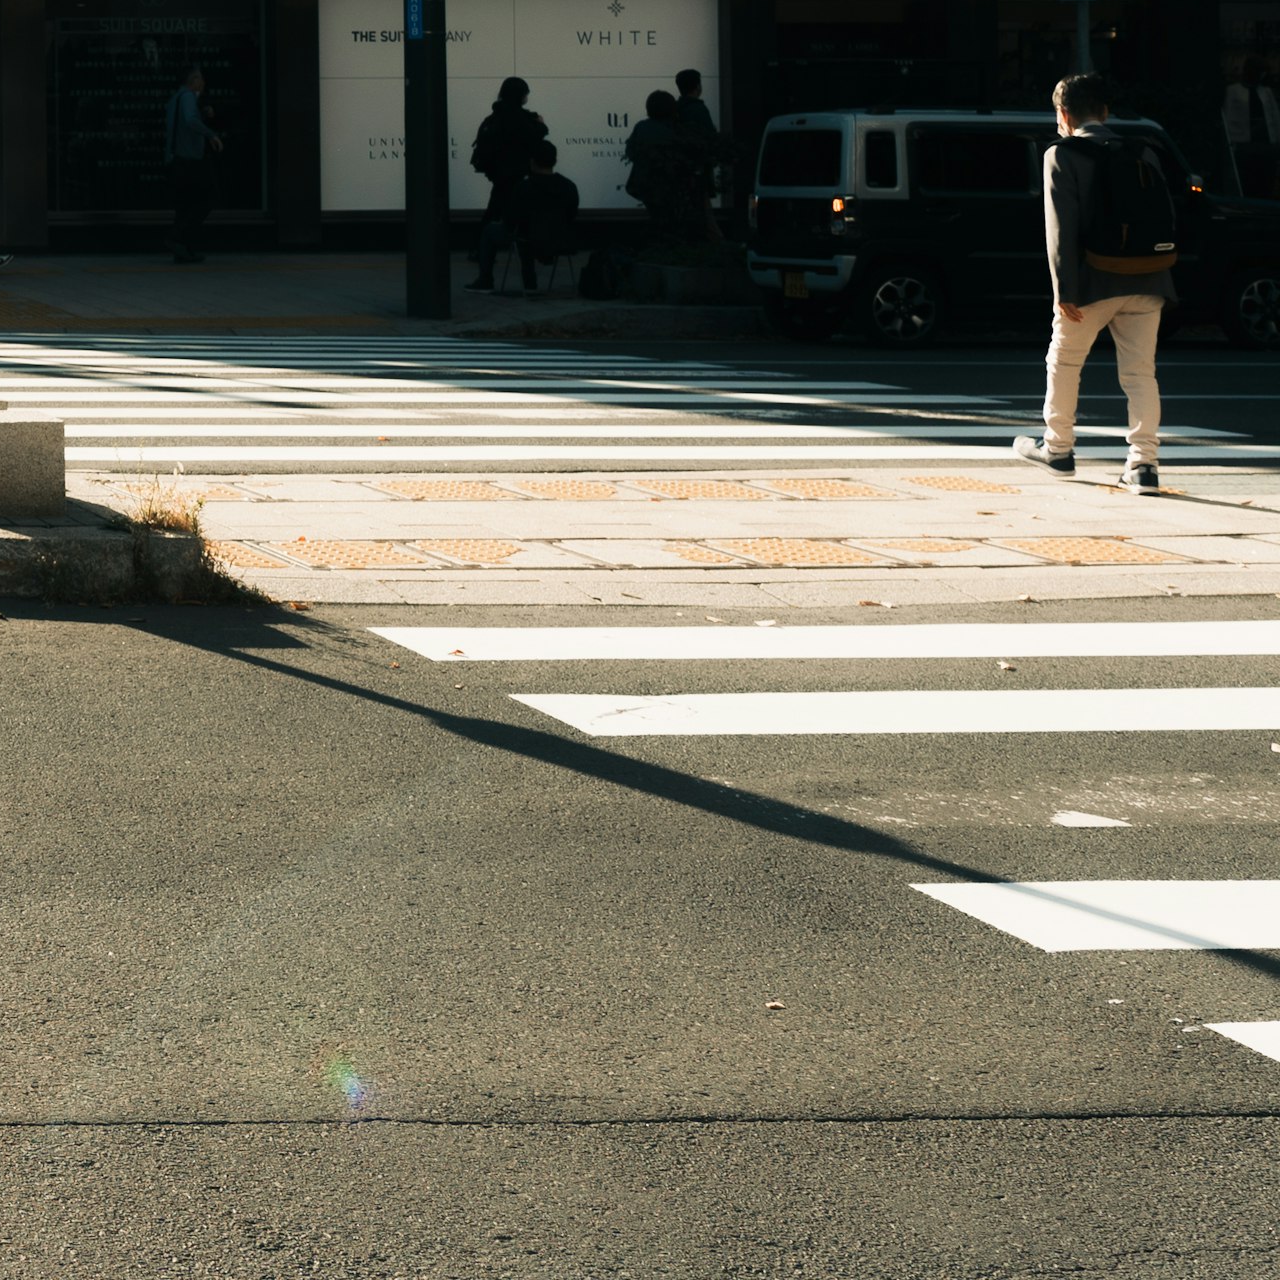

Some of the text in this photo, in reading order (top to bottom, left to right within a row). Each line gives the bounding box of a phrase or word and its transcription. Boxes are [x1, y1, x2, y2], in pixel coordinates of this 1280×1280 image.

[140, 18, 208, 33] SQUARE
[351, 31, 377, 43] THE
[576, 30, 658, 46] WHITE
[565, 137, 615, 145] UNIVERSAL
